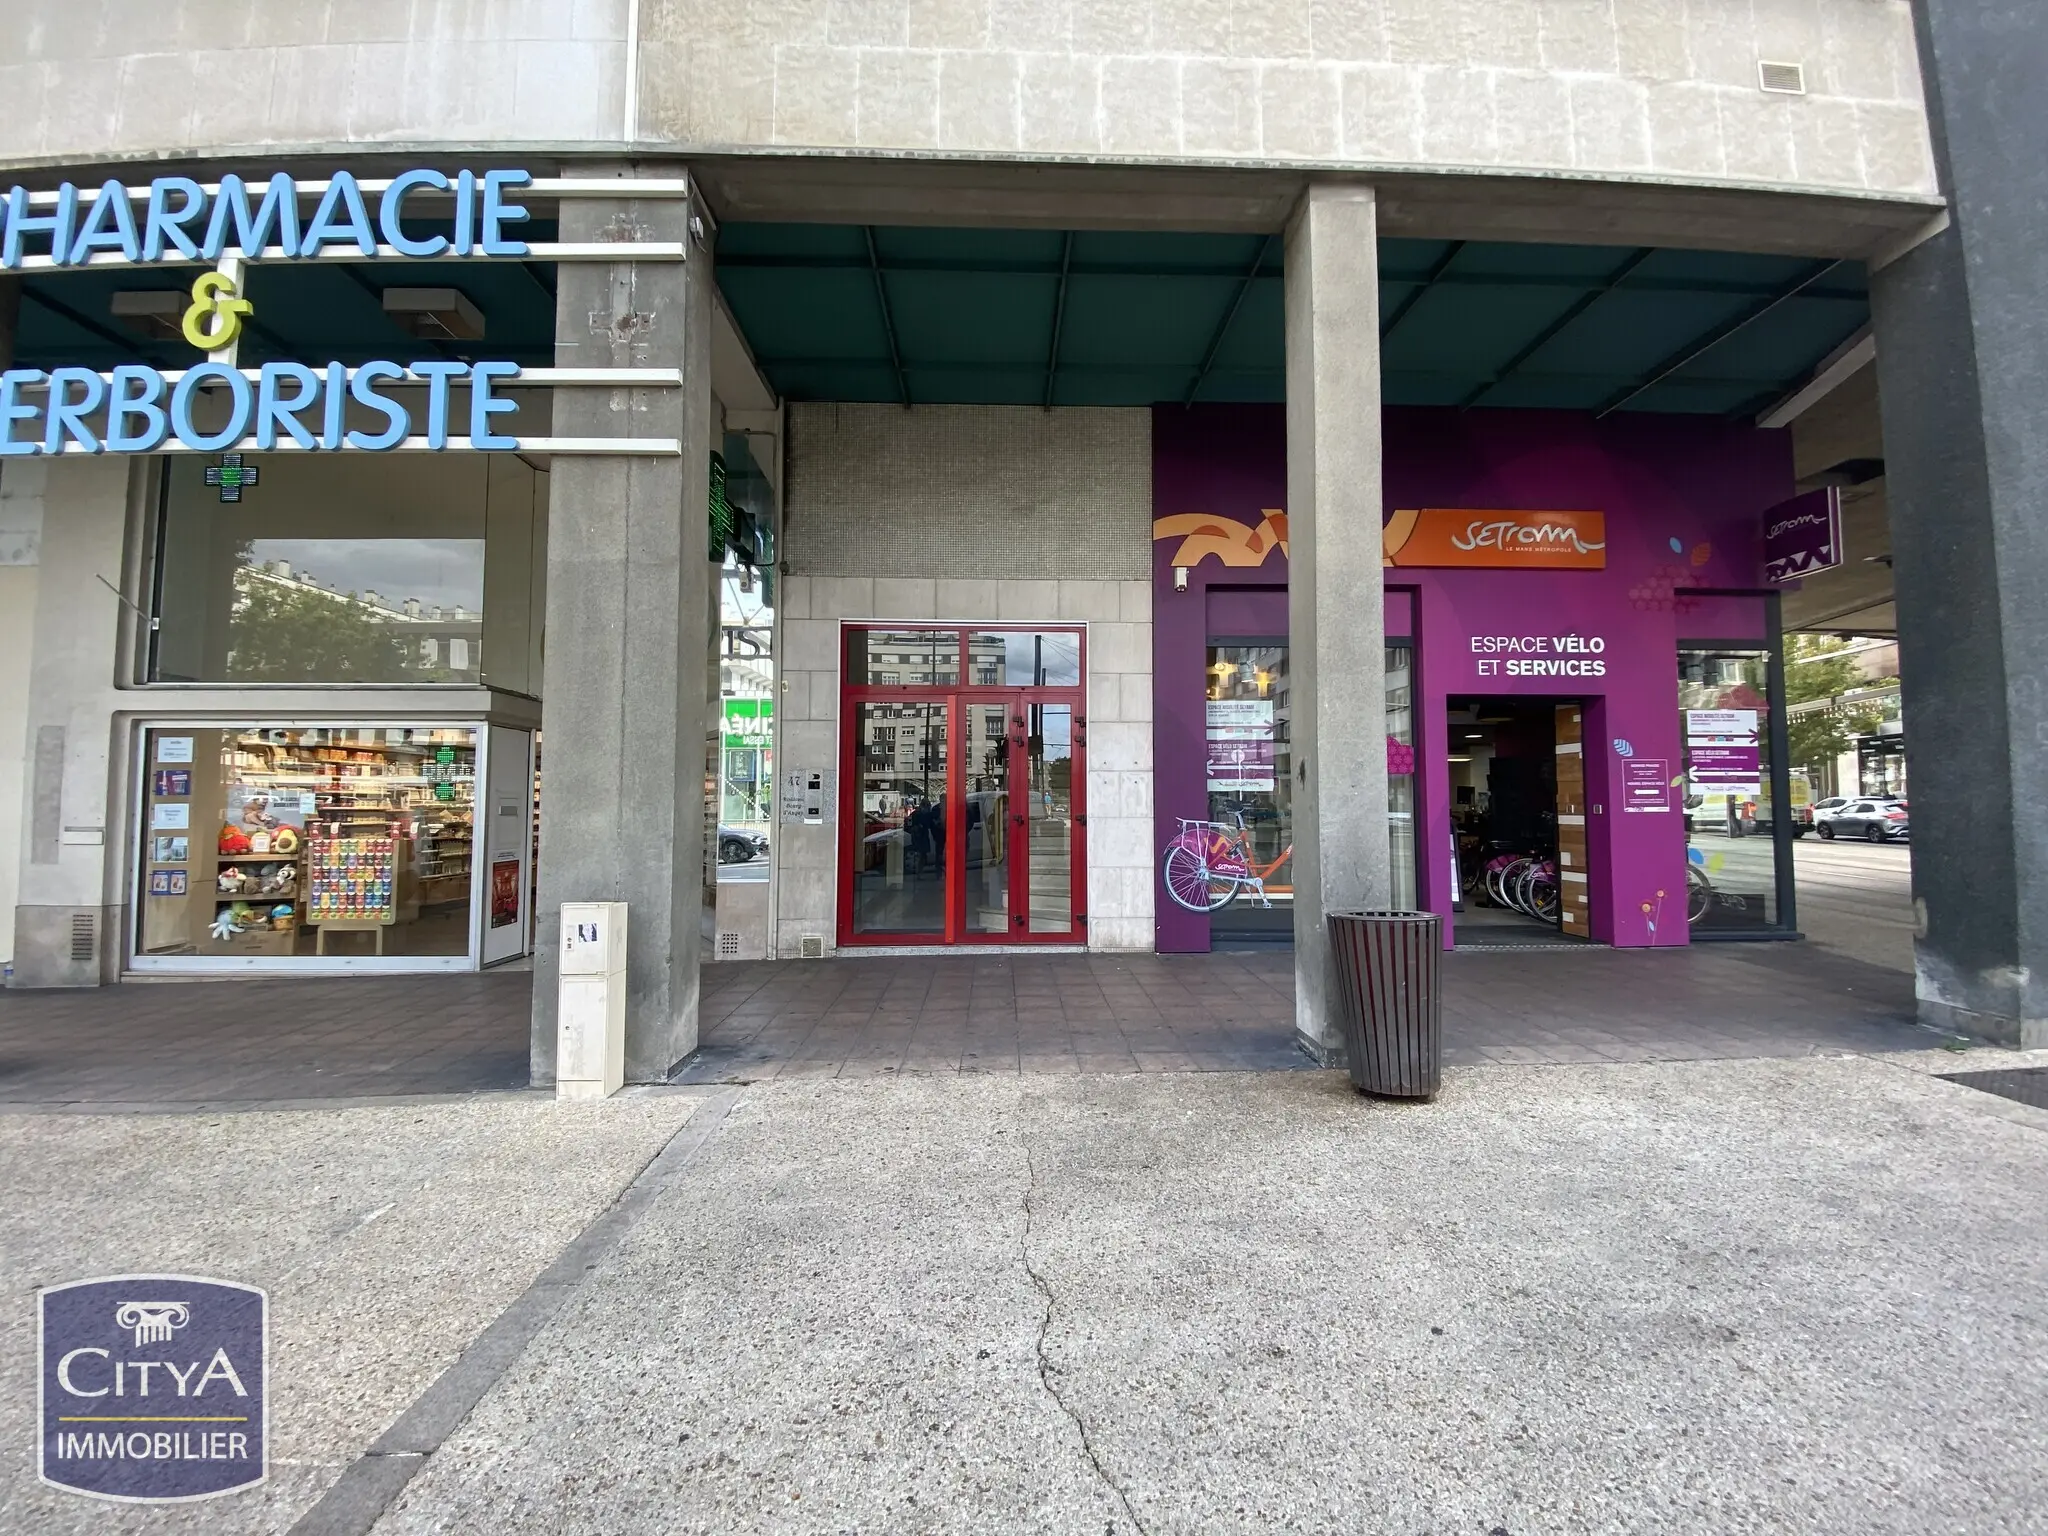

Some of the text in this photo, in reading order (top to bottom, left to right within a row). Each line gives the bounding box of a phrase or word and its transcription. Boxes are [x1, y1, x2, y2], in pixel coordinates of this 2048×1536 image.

[0, 168, 533, 269] HARMACIE
[182, 271, 254, 351] &
[1470, 633, 1605, 654] ESPACE VÉLO
[1478, 659, 1607, 677] ET SERVICES
